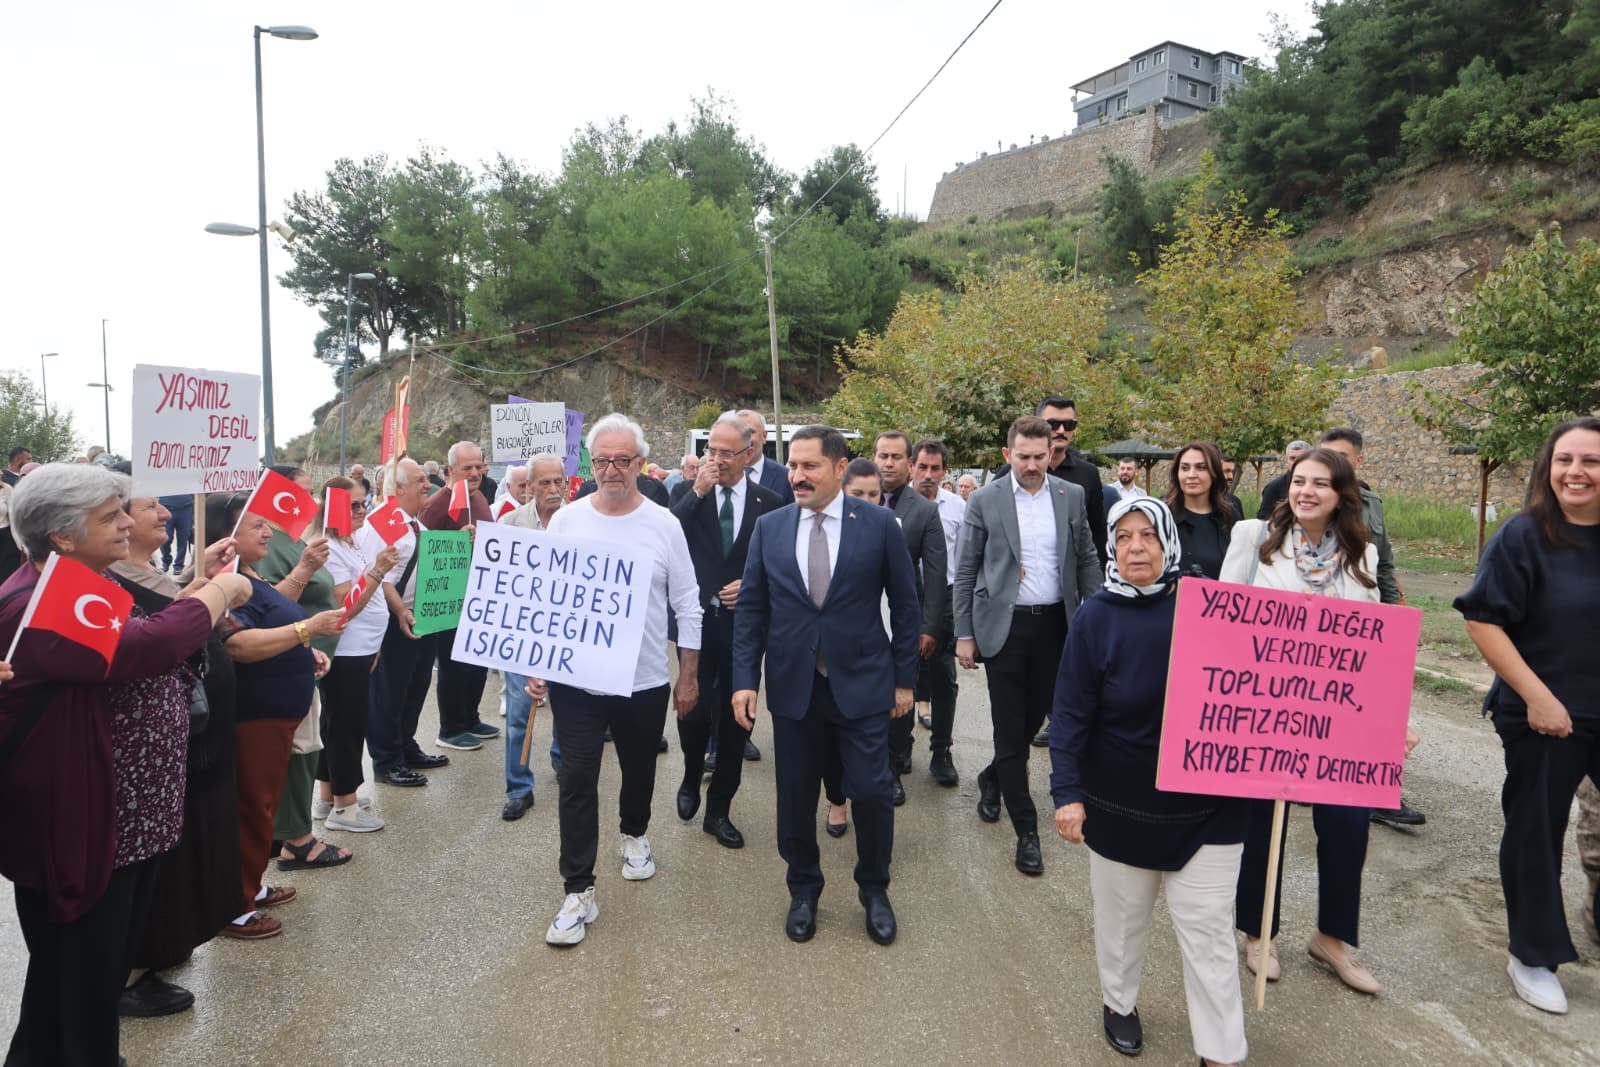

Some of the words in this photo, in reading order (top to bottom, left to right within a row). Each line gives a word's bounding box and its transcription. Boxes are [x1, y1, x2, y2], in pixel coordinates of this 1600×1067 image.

[147, 440, 231, 469] ADIMLARIMIZ
[485, 538, 634, 586] GEÇMİŞİN
[475, 566, 632, 618] TECRÜBESİ
[467, 597, 615, 648] GELECEĞİN
[1201, 587, 1307, 632] YAŞLISINA
[1317, 608, 1384, 643] DEĞER
[464, 629, 574, 674] IŞIĞIDIR
[1252, 635, 1367, 673] VERMEYEN
[1202, 667, 1363, 712] TOPLUMLAR,
[1199, 702, 1332, 739] HAFIZASINI
